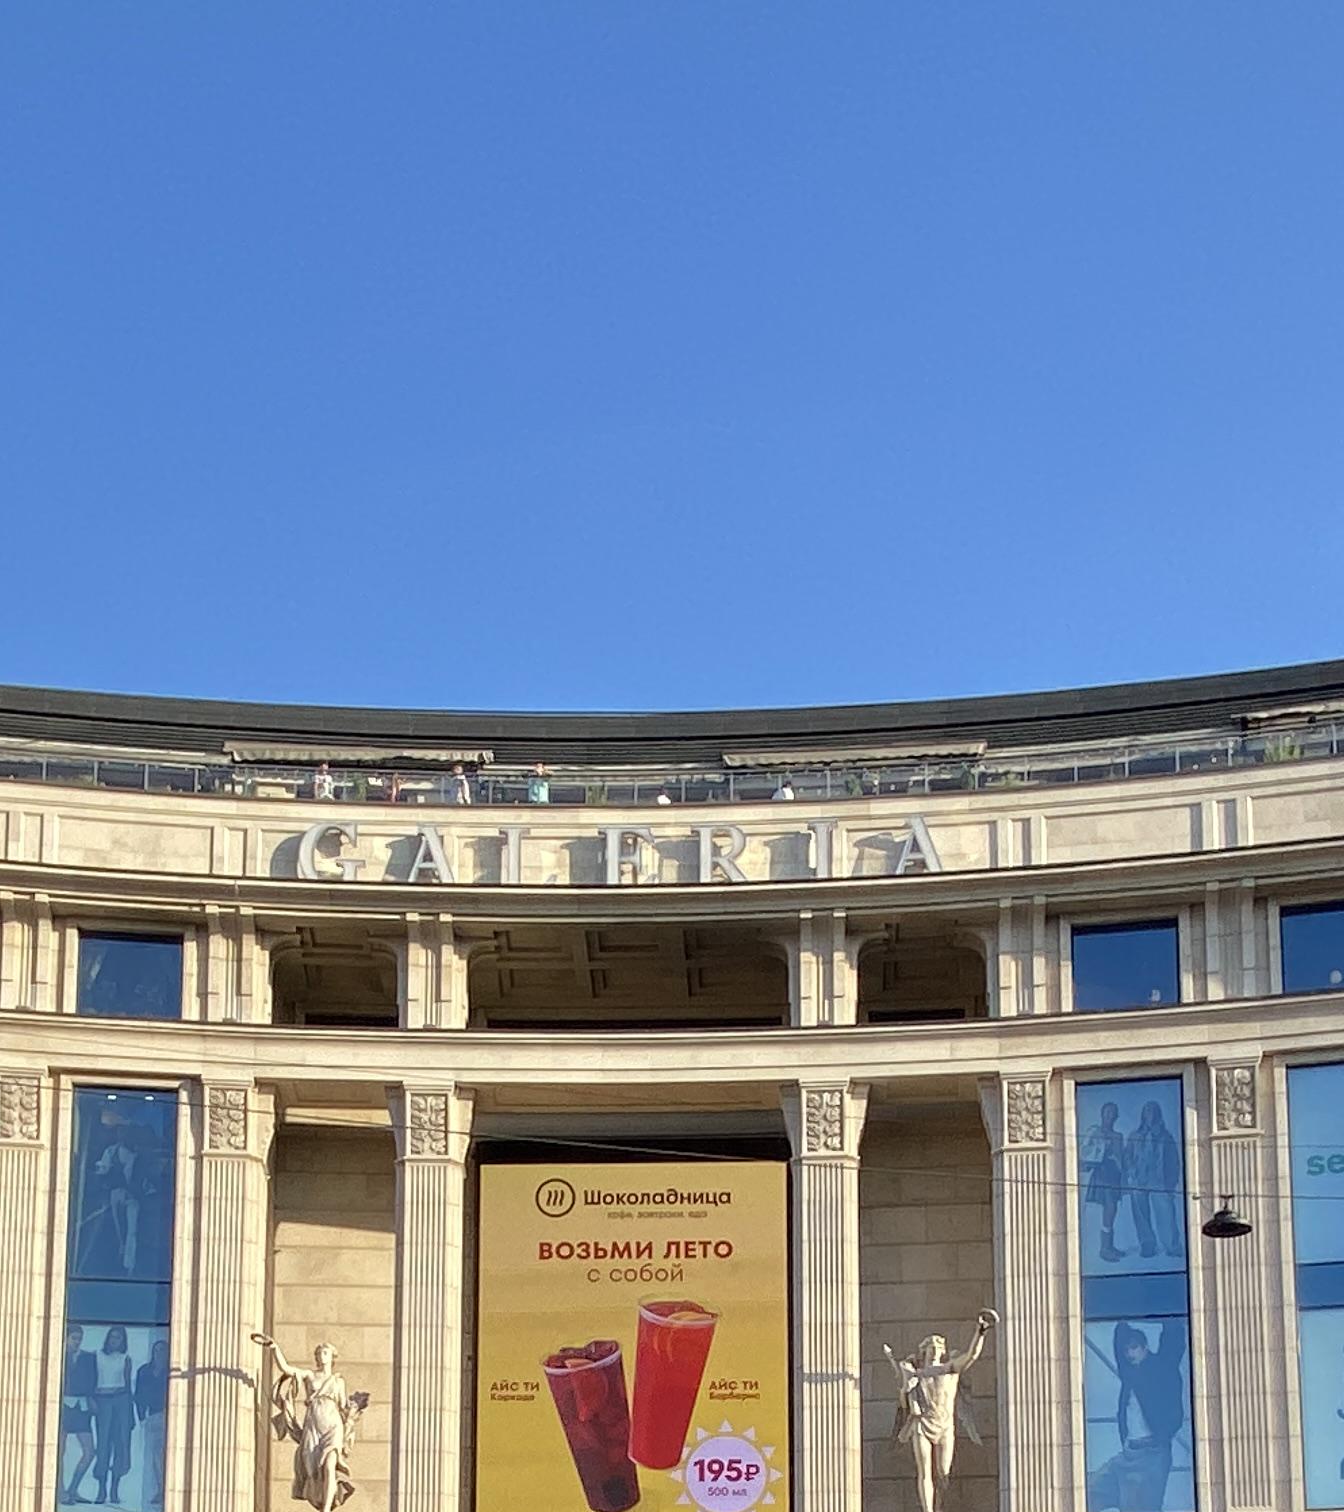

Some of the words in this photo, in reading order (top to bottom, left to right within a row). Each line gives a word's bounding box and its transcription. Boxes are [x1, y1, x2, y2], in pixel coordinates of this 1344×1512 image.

[298, 814, 943, 885] GALERIA
[584, 1188, 731, 1206] Шоколадница
[539, 1241, 653, 1260] ВОЗЬМИ
[663, 1240, 733, 1259] ЛЕТО
[609, 1263, 684, 1282] собой
[490, 1379, 519, 1391] АЙС
[522, 1381, 540, 1391] ТИ
[709, 1378, 738, 1391] АЙС
[742, 1380, 759, 1391] ТИ
[707, 1487, 729, 1497] 500
